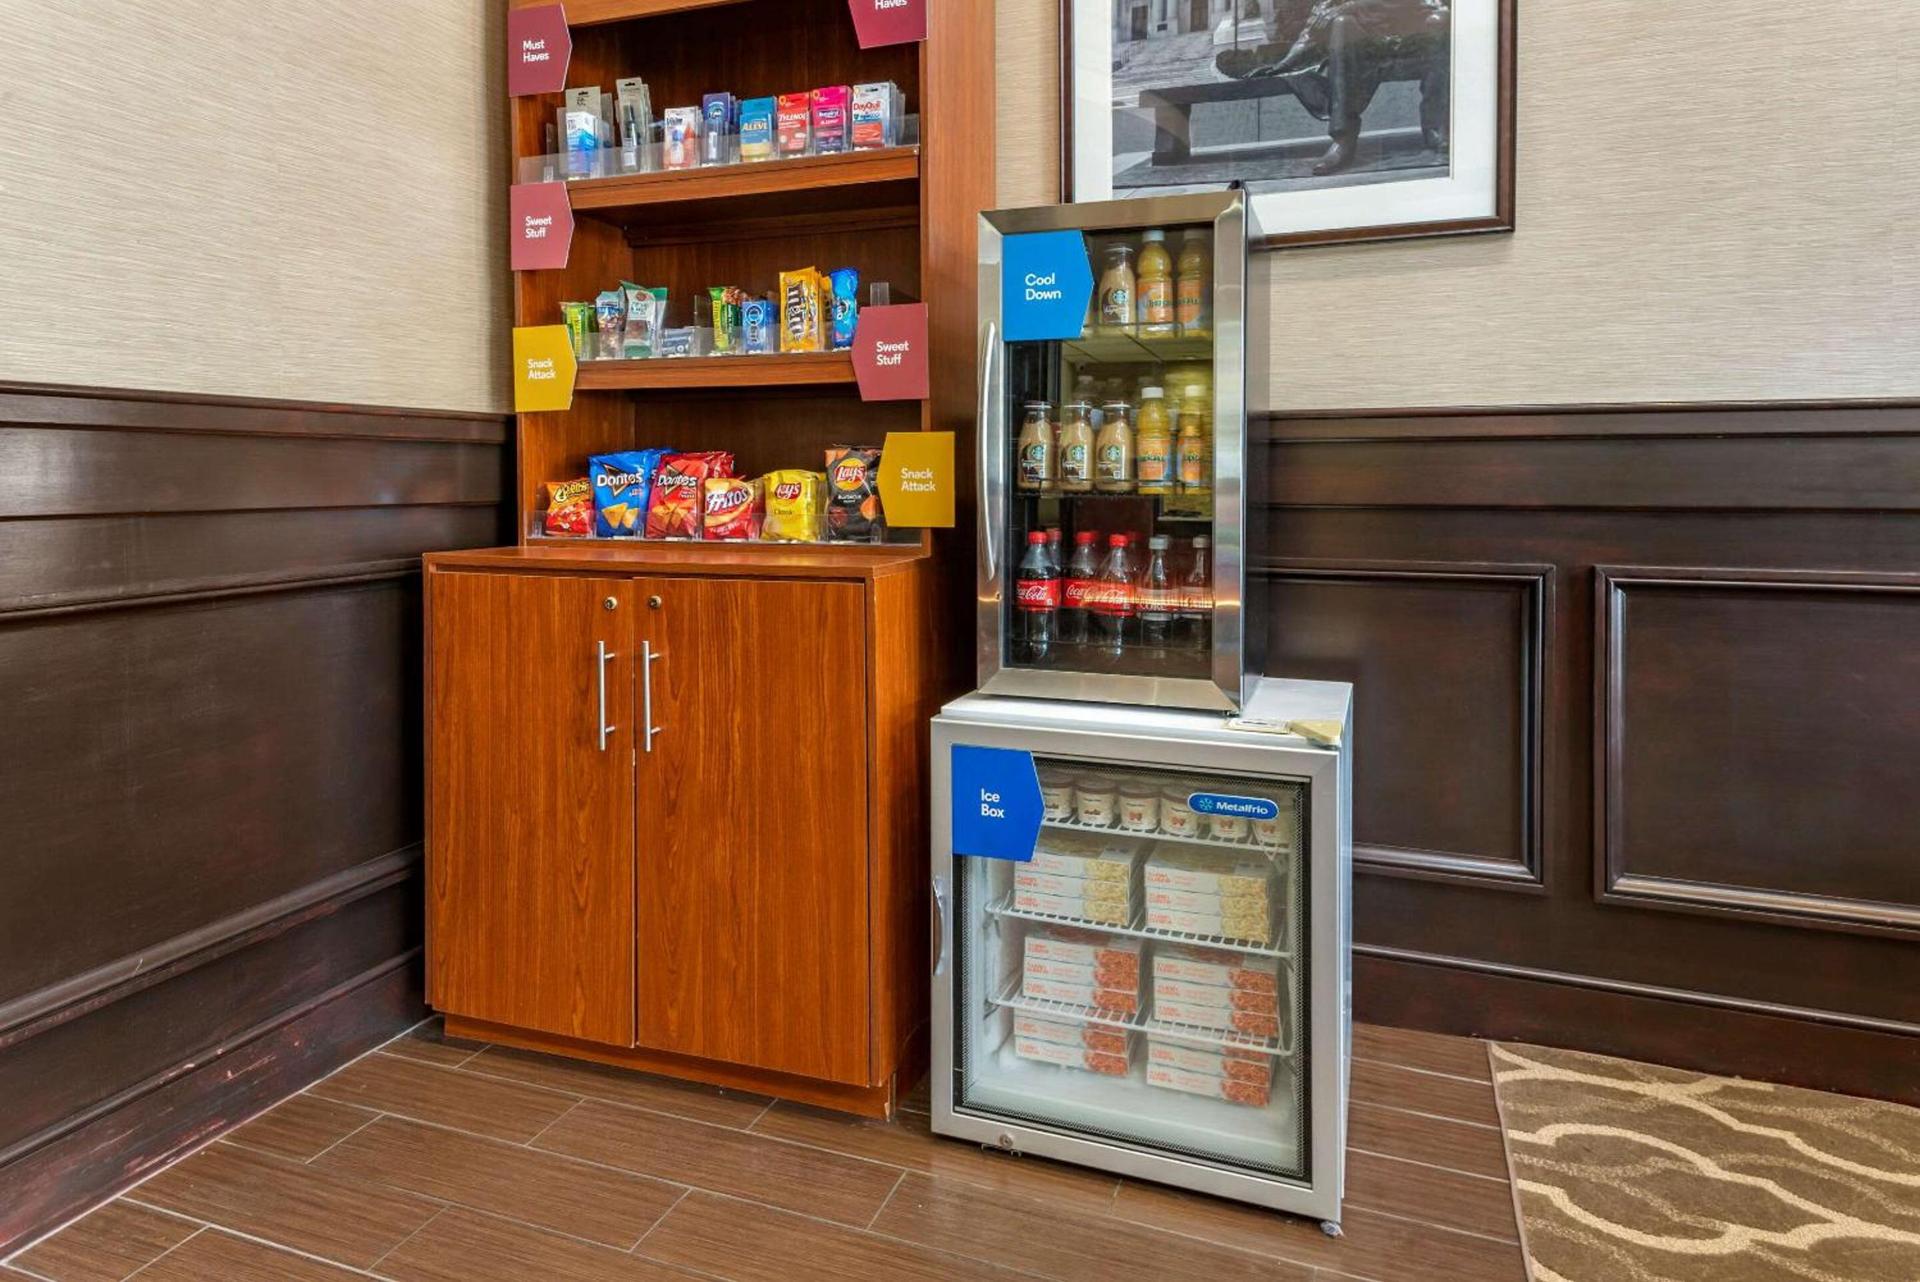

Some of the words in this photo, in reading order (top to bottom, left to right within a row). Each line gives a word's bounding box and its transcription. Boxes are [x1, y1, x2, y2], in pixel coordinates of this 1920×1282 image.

[874, 0, 908, 10] Haves
[522, 39, 545, 51] Must
[522, 52, 550, 63] Haves
[525, 215, 552, 226] Sweet
[525, 227, 546, 239] Stuff
[1024, 272, 1056, 286] Cool
[1025, 288, 1062, 301] Down
[876, 340, 910, 353] Sweet
[527, 358, 553, 369] Snack
[876, 353, 902, 366] Stuff
[527, 369, 556, 379] Attack
[901, 467, 933, 479] Snack
[901, 480, 936, 492] Attack
[981, 788, 1000, 802] Ice
[981, 803, 1005, 818] Box
[1216, 801, 1269, 815] Metalfrio
